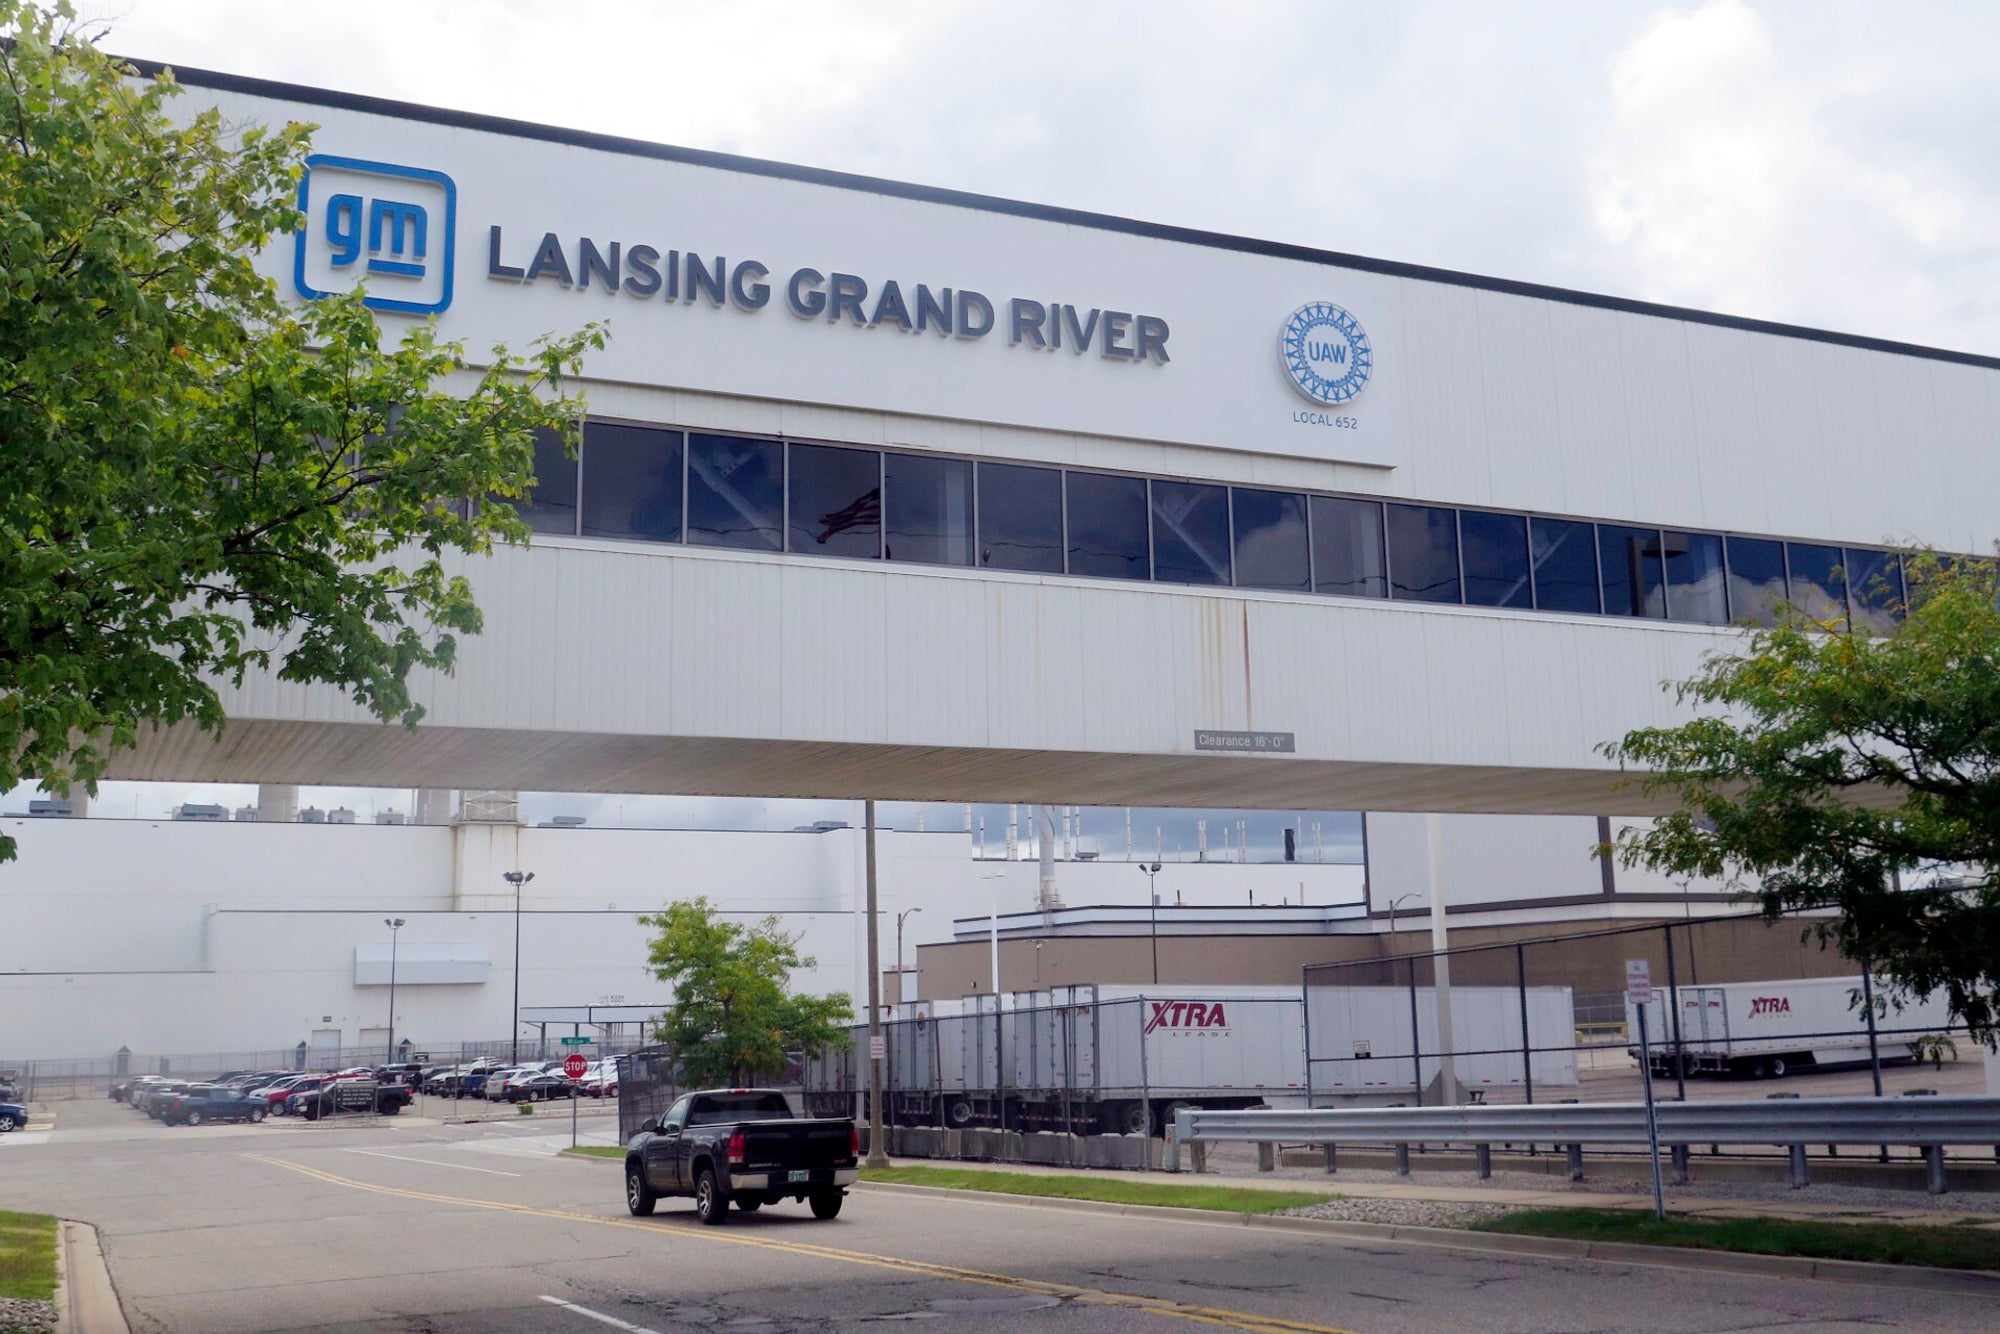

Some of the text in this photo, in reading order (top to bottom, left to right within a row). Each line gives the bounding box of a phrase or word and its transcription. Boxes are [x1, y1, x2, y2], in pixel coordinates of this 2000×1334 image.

[325, 193, 428, 278] gm
[488, 225, 1170, 364] LANSING GRAND RIVER
[1308, 340, 1347, 364] UAW
[1293, 411, 1358, 429] LOCAL 652
[1199, 734, 1251, 747] Clearance
[1144, 1000, 1226, 1035] XTRA
[1748, 997, 1790, 1019] XTRA
[565, 1061, 586, 1072] STOP
